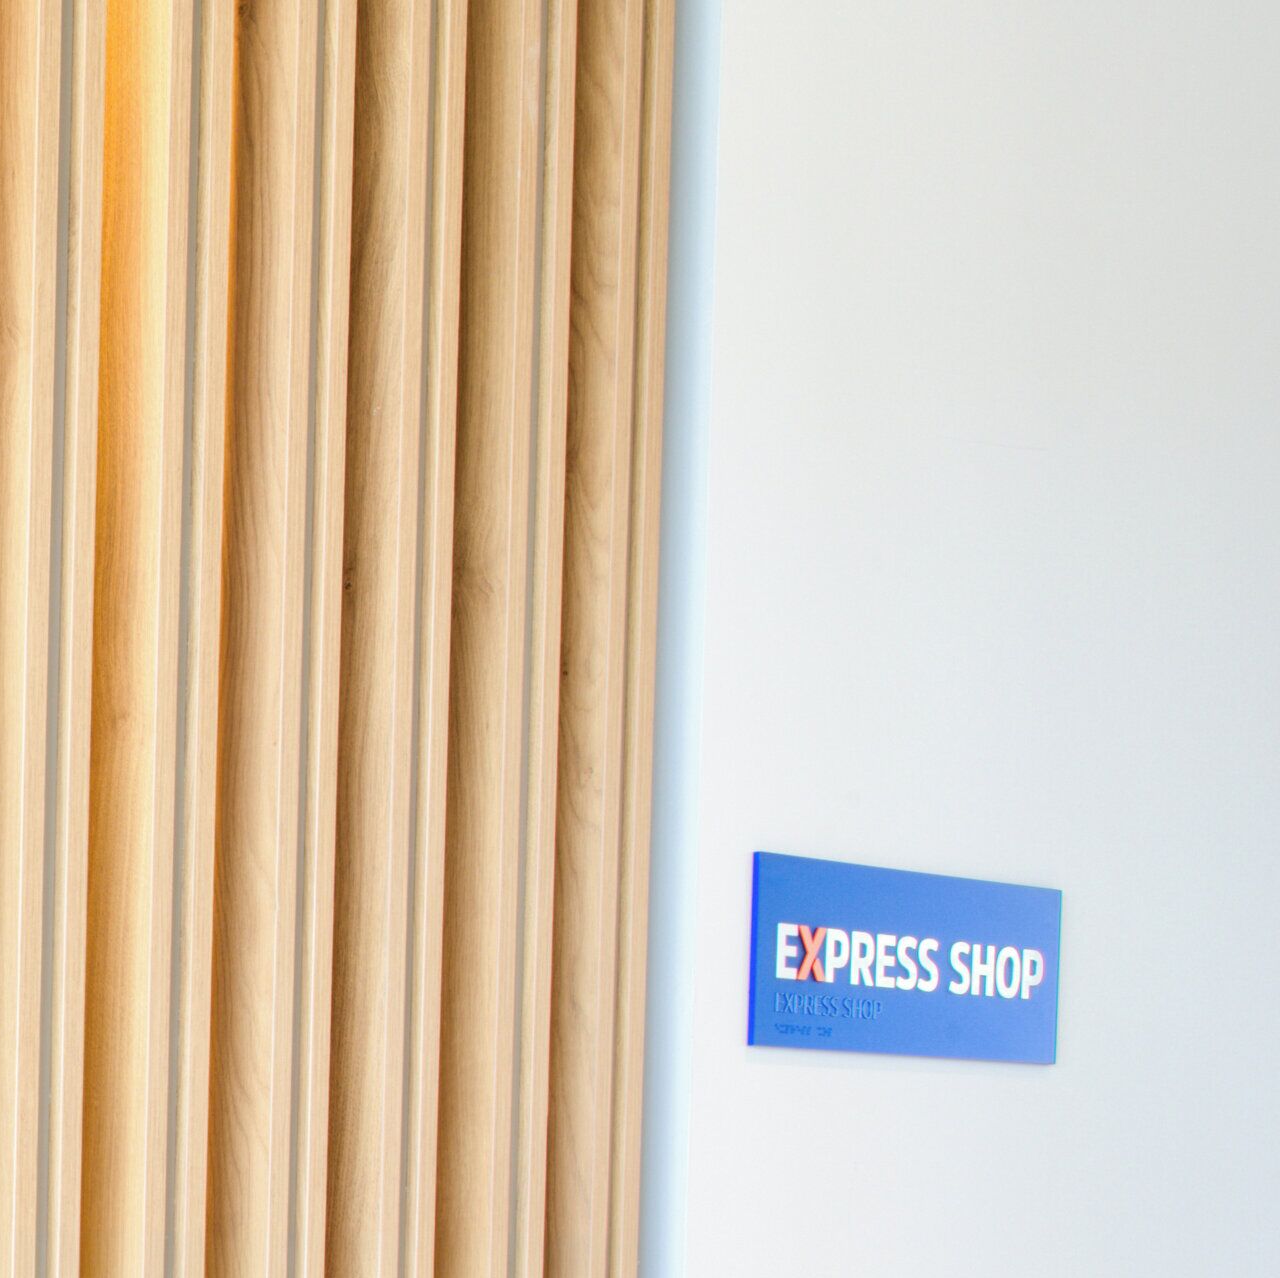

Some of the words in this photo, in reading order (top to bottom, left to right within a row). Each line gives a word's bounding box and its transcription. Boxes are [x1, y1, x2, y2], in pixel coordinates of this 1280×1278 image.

[776, 922, 939, 992] EXPRESS
[948, 942, 1043, 999] SHOP
[775, 992, 839, 1018] EXPRESS
[842, 997, 883, 1020] SHOP
